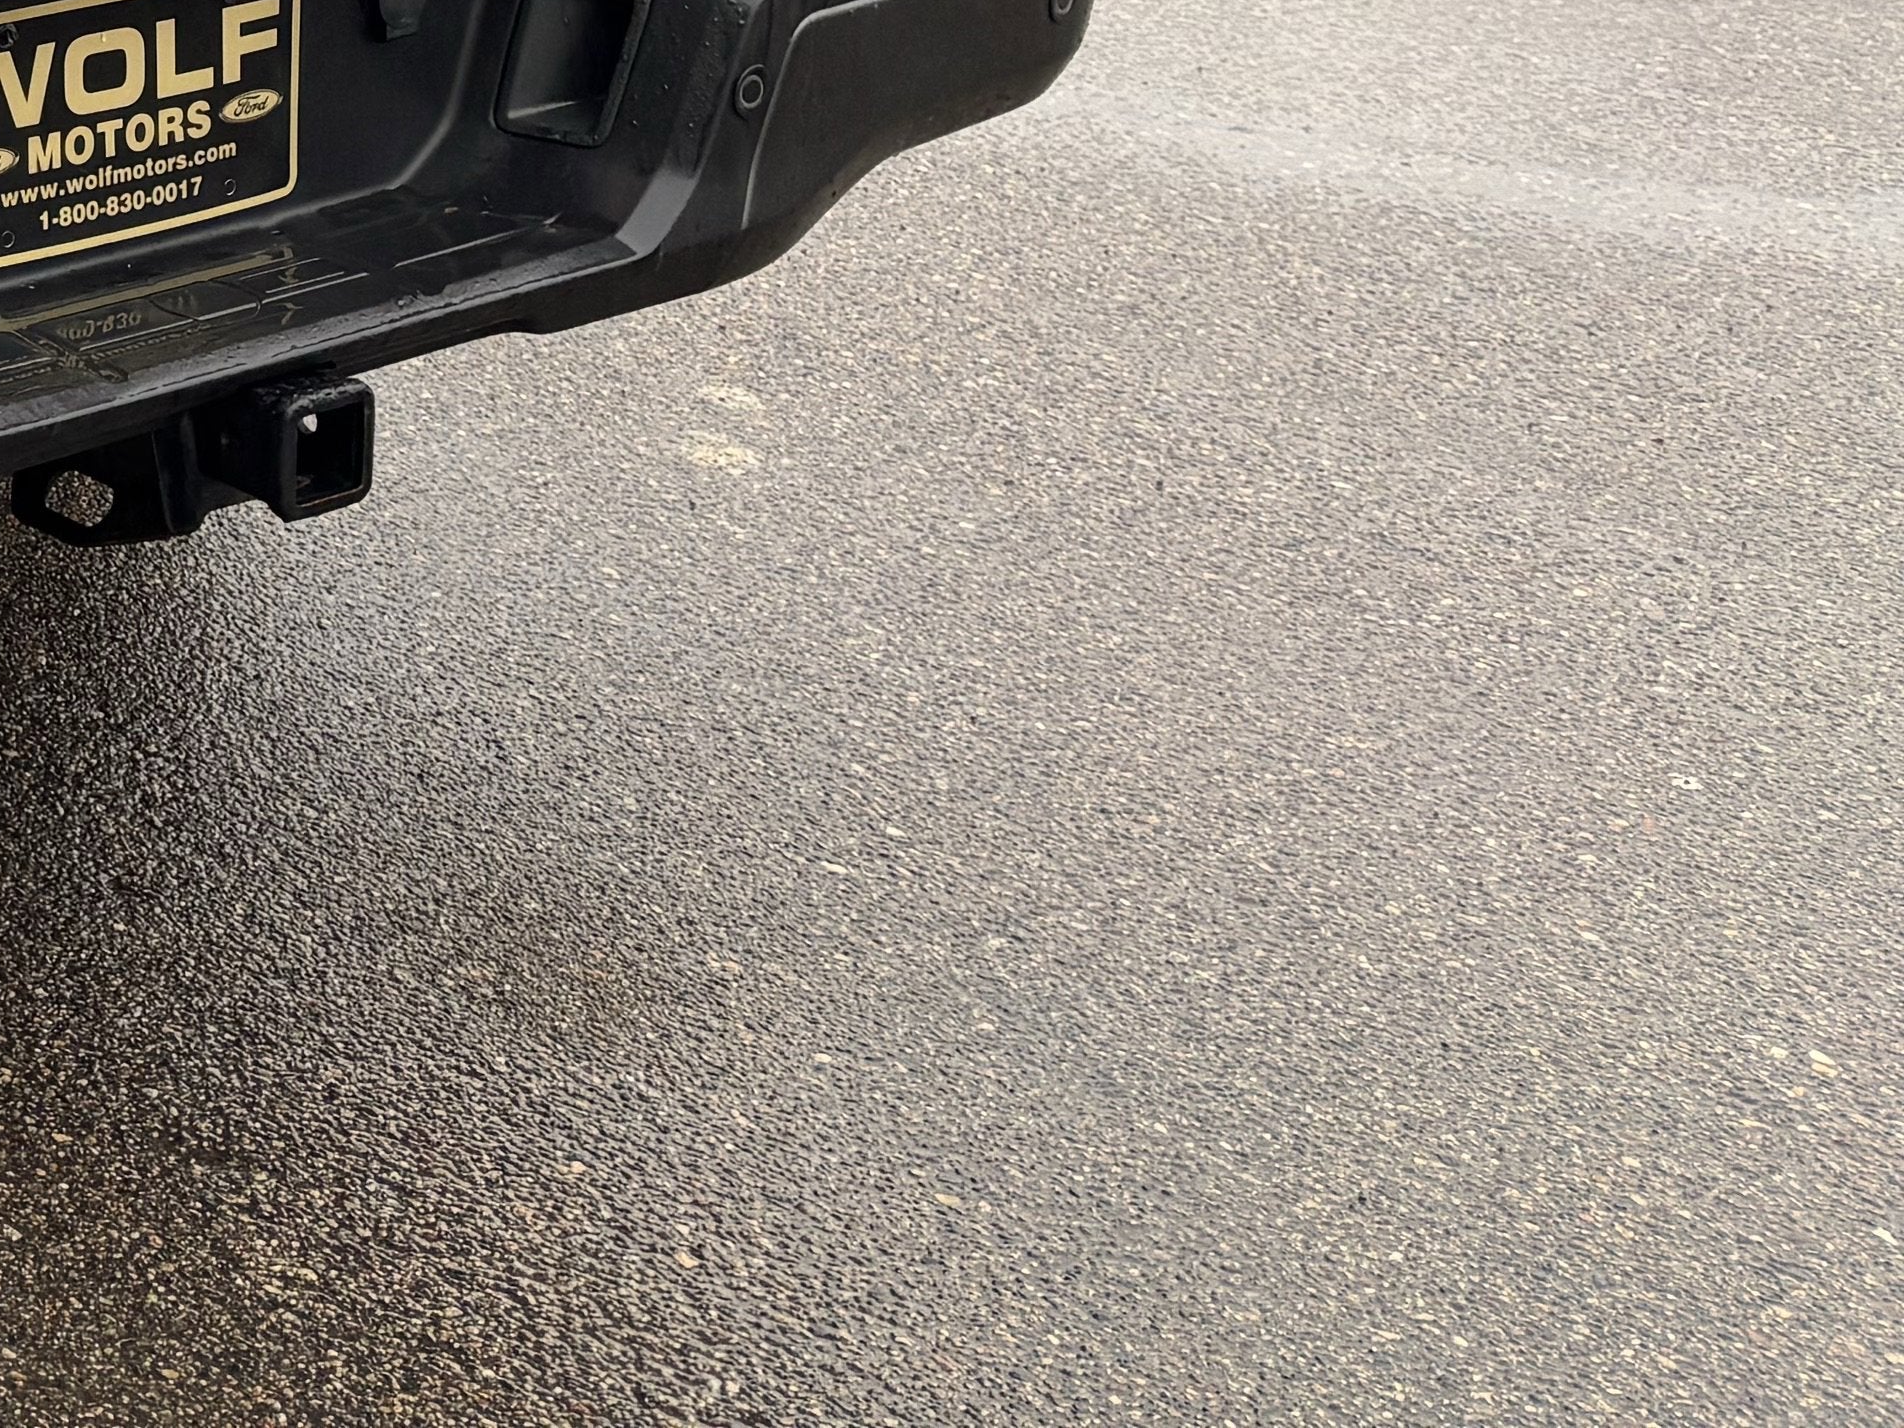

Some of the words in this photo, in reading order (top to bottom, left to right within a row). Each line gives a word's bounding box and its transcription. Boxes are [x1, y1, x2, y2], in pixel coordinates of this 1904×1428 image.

[28, 100, 212, 175] MOTORS
[0, 140, 237, 209] www.wolfmotors.com
[39, 175, 204, 232] 1-800-830-0017
